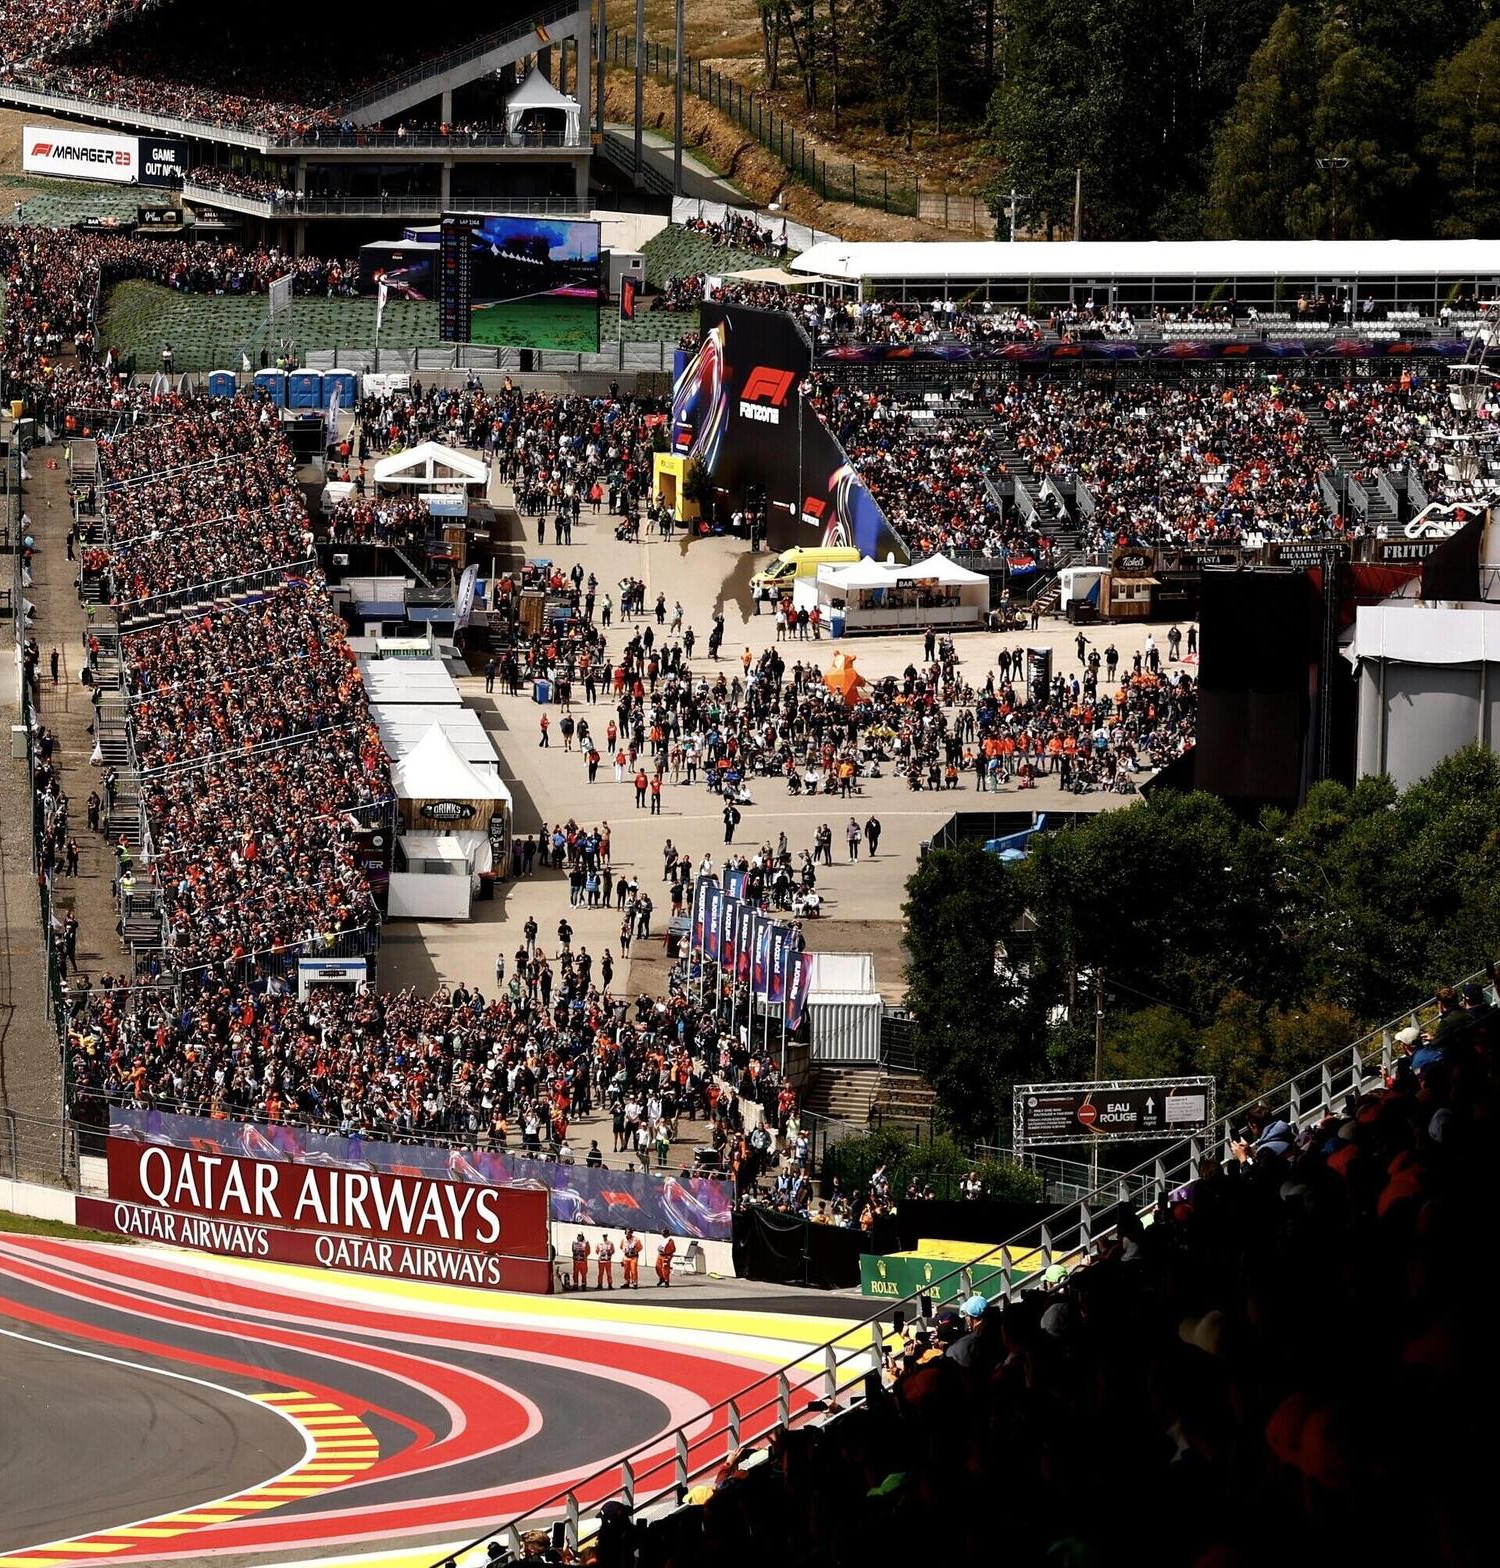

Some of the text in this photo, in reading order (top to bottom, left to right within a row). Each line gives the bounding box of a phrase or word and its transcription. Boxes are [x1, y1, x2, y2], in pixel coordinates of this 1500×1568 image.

[52, 145, 114, 165] MANAGER
[115, 151, 131, 166] 23
[152, 148, 175, 162] GAME
[145, 162, 161, 175] OUT
[1197, 555, 1221, 564] PASTA
[433, 803, 461, 814] DRINKS
[1107, 1103, 1130, 1113] EAU
[1100, 1112, 1138, 1123] ROUGE
[138, 1147, 501, 1244] QATAR AIRWAYS
[114, 1204, 269, 1255] QATAR AIRWAYS
[315, 1236, 501, 1285] QATAR AIRWAYS
[871, 1281, 899, 1294] ROLEX
